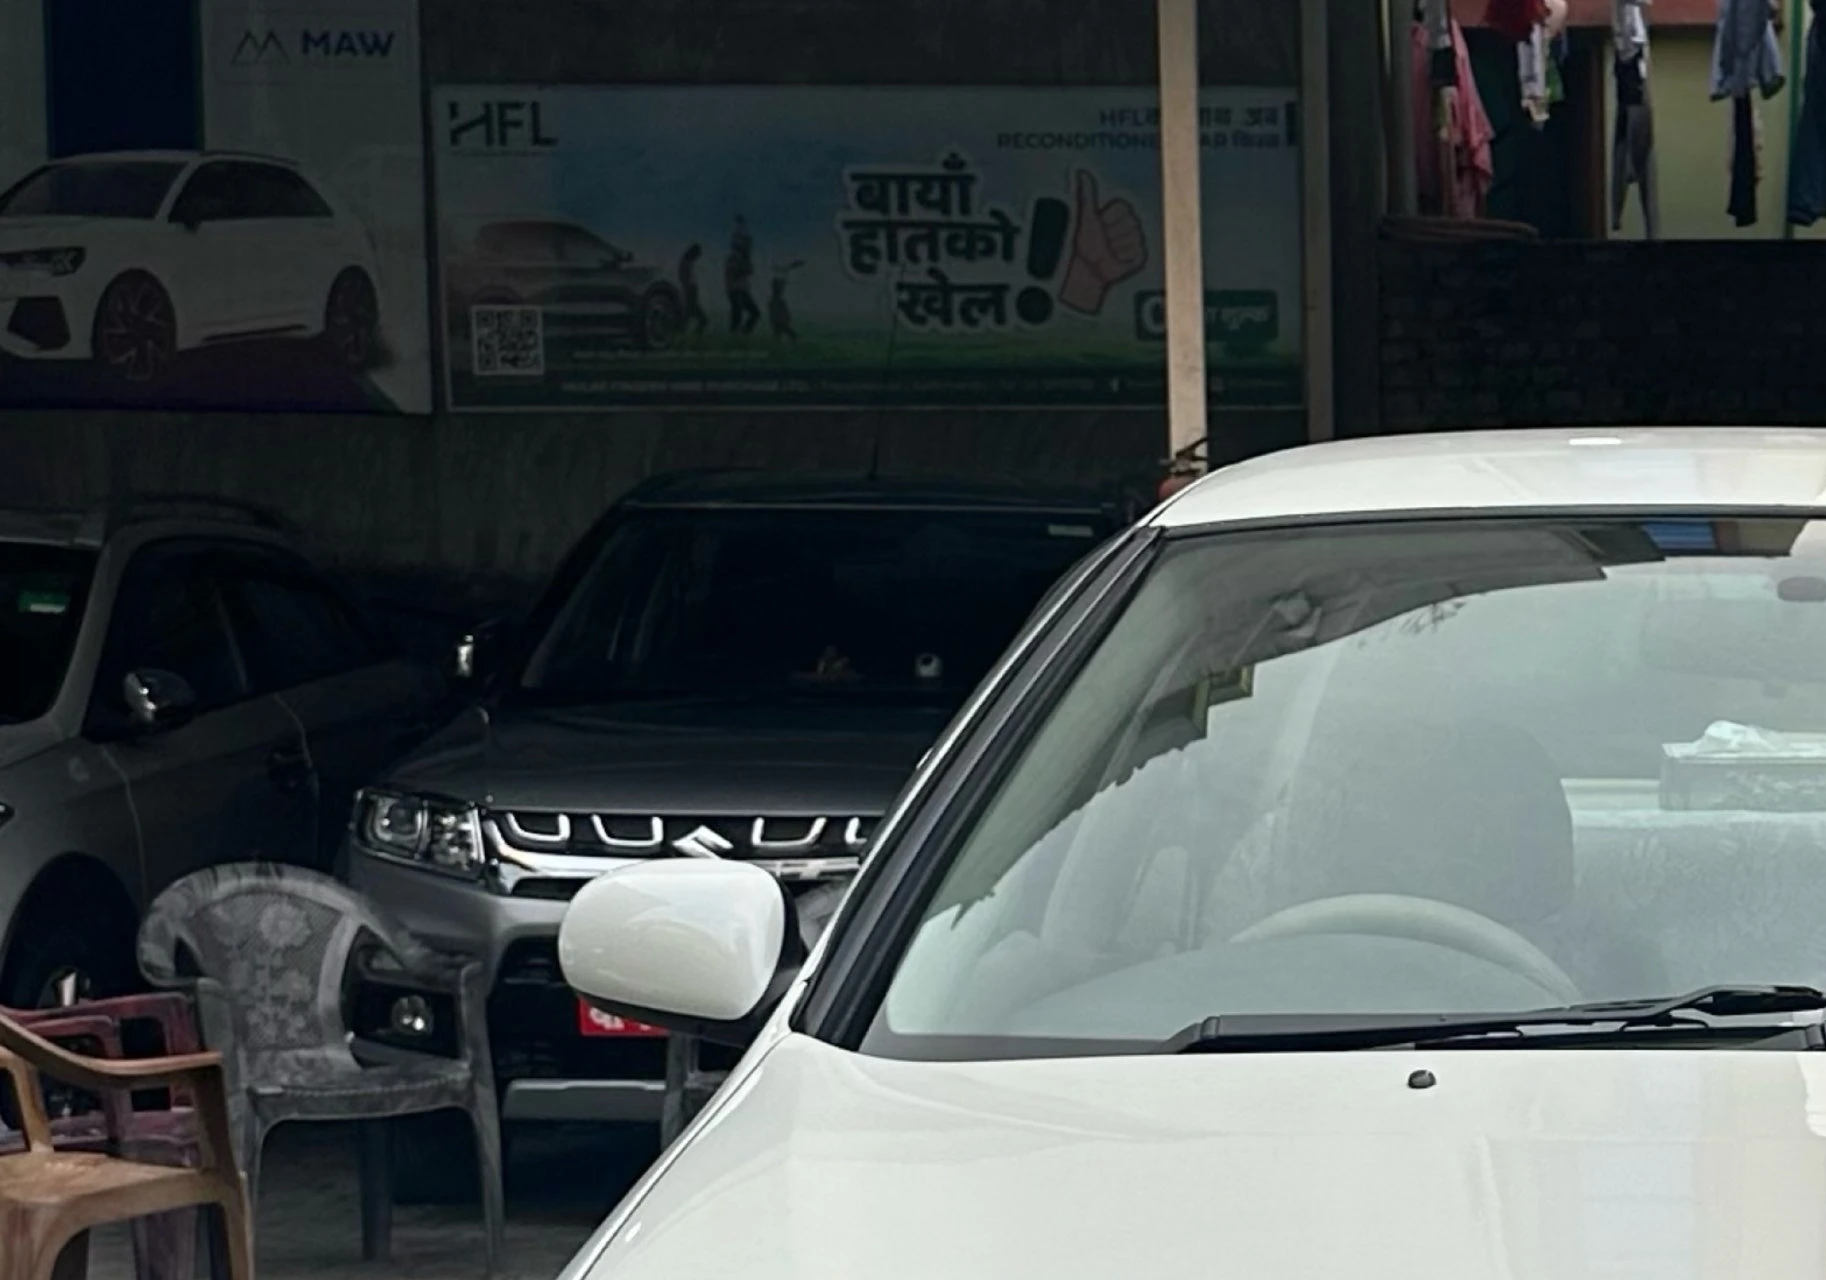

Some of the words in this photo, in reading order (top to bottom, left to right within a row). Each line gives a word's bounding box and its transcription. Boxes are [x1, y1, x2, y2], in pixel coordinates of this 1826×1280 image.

[302, 29, 396, 57] MAW
[449, 101, 558, 147] HFL
[852, 151, 976, 215] बायाँ
[842, 209, 1021, 274] हातको
